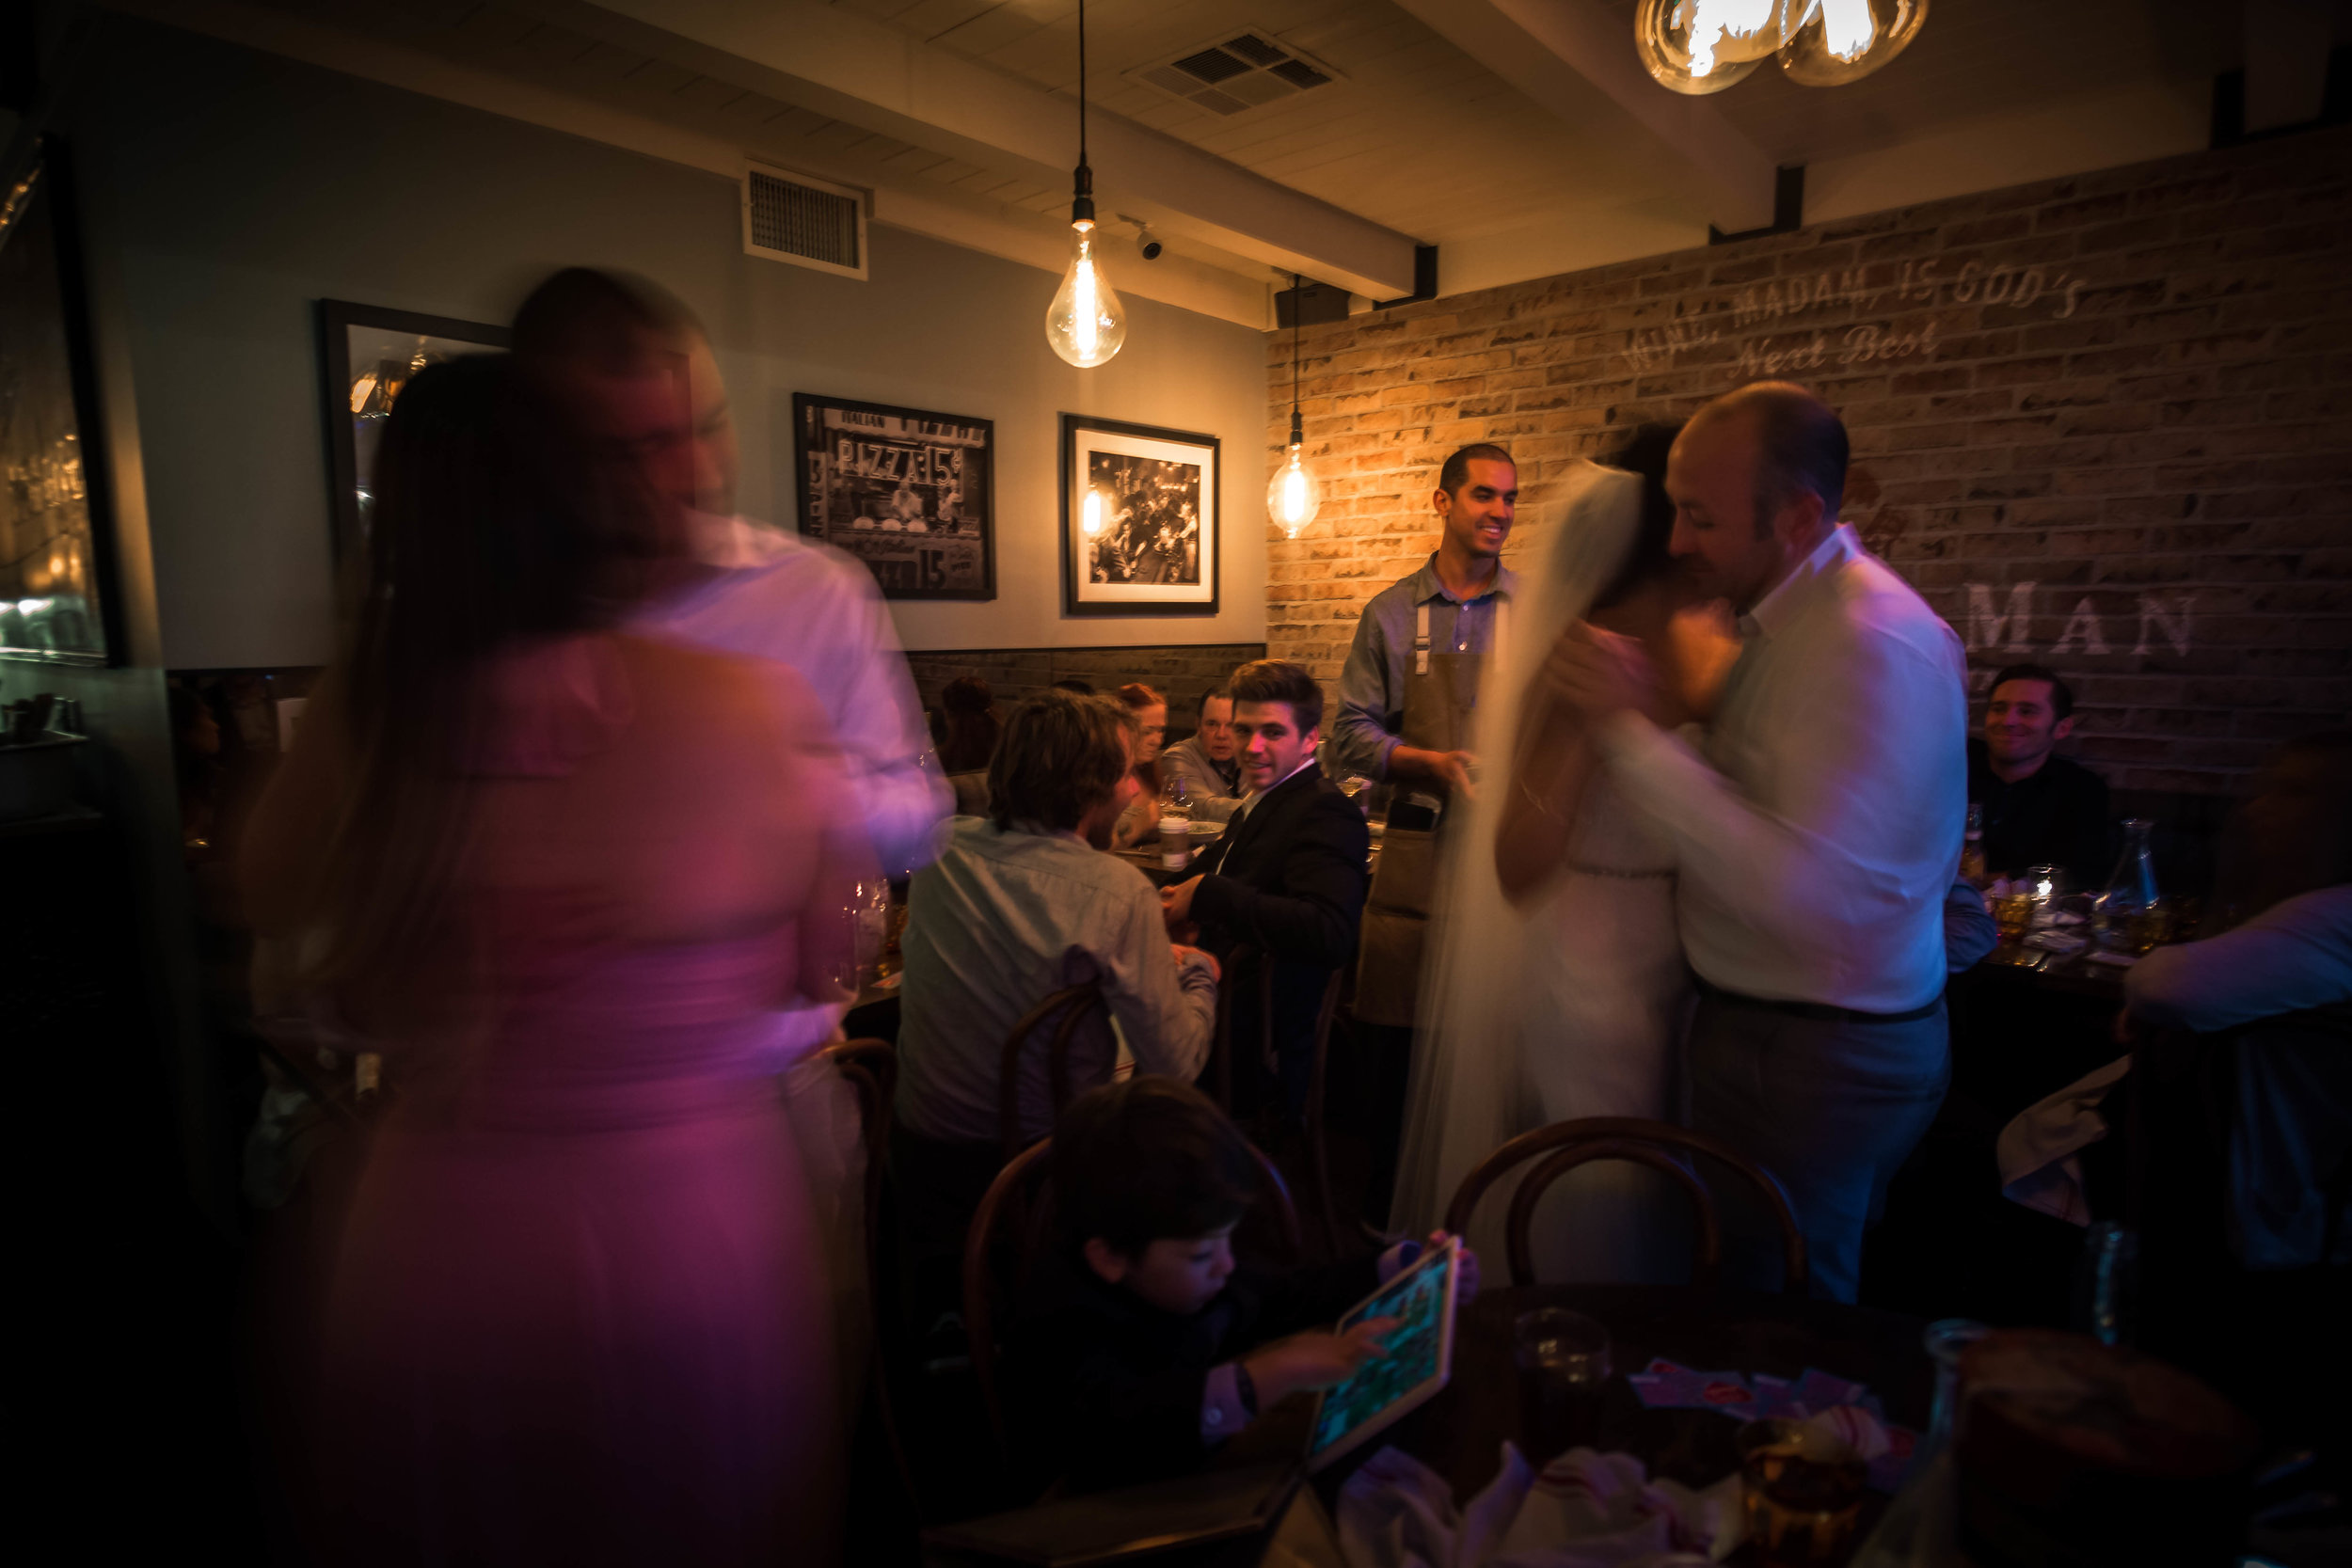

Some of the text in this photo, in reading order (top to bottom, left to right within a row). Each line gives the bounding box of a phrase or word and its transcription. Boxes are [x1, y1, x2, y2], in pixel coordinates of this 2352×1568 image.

[1733, 266, 1880, 329] MADAM,
[1897, 261, 1938, 301] IS
[1727, 320, 1941, 380] Next Best
[837, 438, 919, 483] PIZZA
[1963, 579, 2198, 657] MAN
